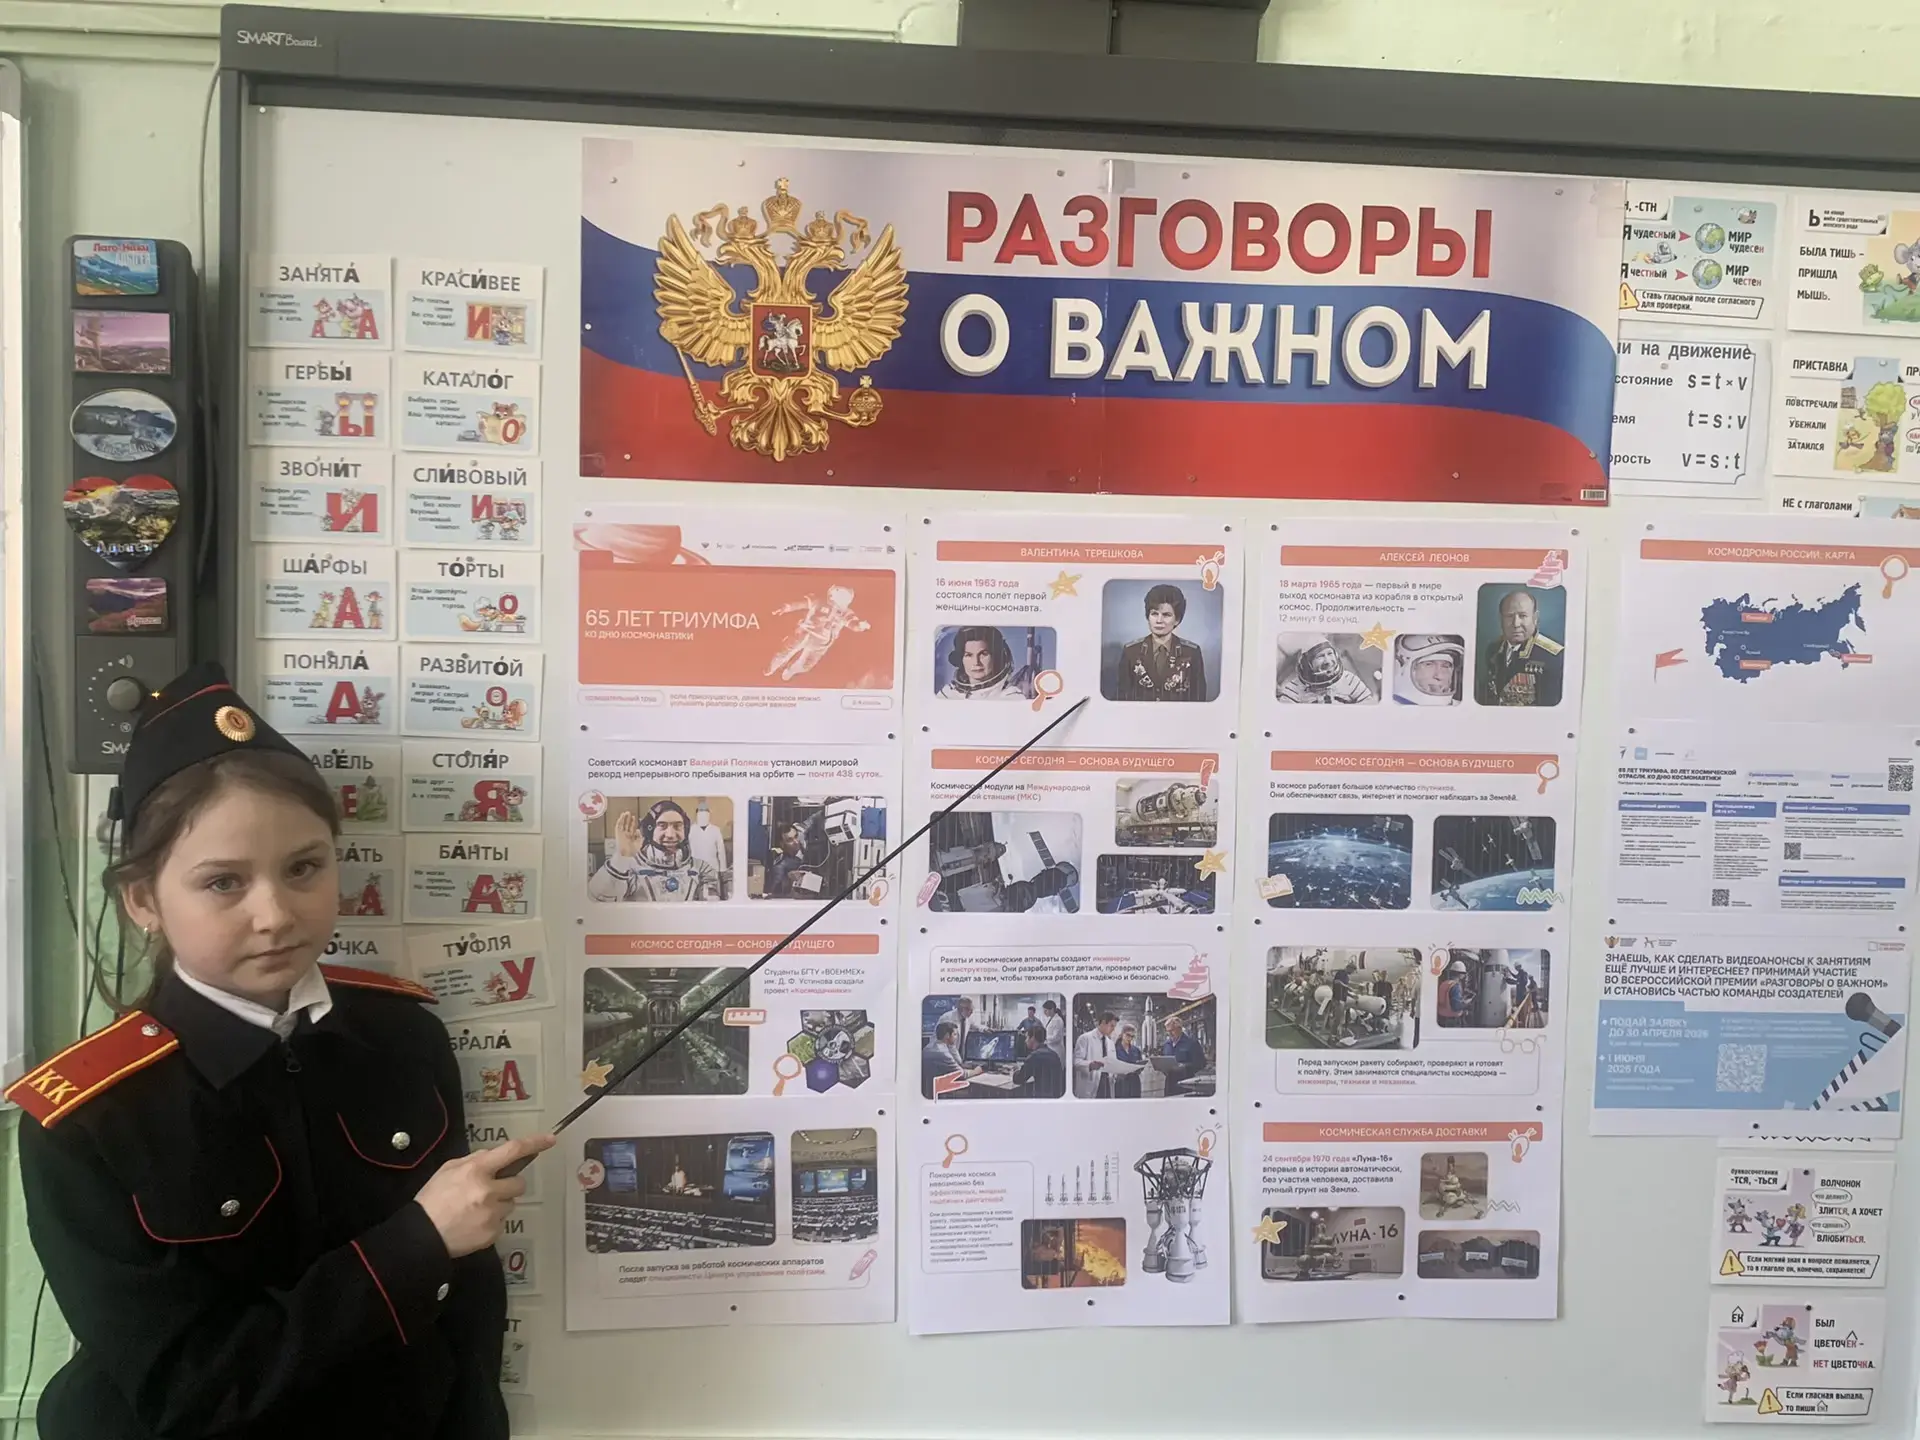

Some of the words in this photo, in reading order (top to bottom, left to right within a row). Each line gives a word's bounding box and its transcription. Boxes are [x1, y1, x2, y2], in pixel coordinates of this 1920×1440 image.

[237, 30, 286, 45] SMART
[1808, 208, 1820, 226] Ь
[946, 190, 1492, 278] РАЗГОВОРЫ
[1633, 229, 1676, 241] чудесный
[1728, 231, 1752, 242] МИР
[1729, 243, 1764, 254] чудесен
[1799, 246, 1826, 256] БЫЛА
[1829, 248, 1856, 258] ТИШЬ
[1630, 268, 1667, 278] честный
[1725, 265, 1749, 276] МИР
[1798, 268, 1837, 280] ПРИШЛА
[1732, 277, 1761, 286] честен
[1641, 290, 1661, 300] Ставь
[1664, 292, 1693, 303] гласный
[1695, 294, 1716, 303] после
[1717, 295, 1756, 306] согласного
[1797, 289, 1830, 301] МЫШЬ.
[1641, 301, 1654, 311] для
[1657, 302, 1693, 313] проверки.
[940, 293, 1010, 377] О
[1050, 297, 1491, 390] ВАЖНОМ
[1641, 343, 1660, 356] на
[1668, 345, 1751, 361] движение
[1792, 359, 1848, 373] ПРИСТАВКА
[1785, 397, 1838, 410] ПОВСТРЕЧАЛИ
[1789, 418, 1827, 431] УБЕЖАЛИ
[1787, 440, 1825, 452] ЗАТАИЛСЯ
[1782, 497, 1794, 507] НЕ
[1797, 500, 1803, 508] с
[1804, 498, 1853, 512] глаголами
[1019, 546, 1080, 557] ВАЛЕНТИНА
[1085, 548, 1144, 559] ТЕРЕШКОВА
[1379, 551, 1424, 564] АЛЕКСЕЙ
[1430, 552, 1471, 564] ЛЕОНОВ
[1707, 547, 1778, 558] КОСМОДРОМЫ
[1825, 551, 1856, 560] КАРТА
[935, 577, 945, 587] 16
[948, 580, 971, 588] июня
[974, 578, 995, 587] 1963
[998, 579, 1020, 588] года
[1279, 579, 1288, 587] 18
[1290, 581, 1317, 589] марта
[1319, 580, 1340, 588] 1965
[1375, 581, 1409, 590] первый
[1411, 581, 1416, 591] в
[1418, 583, 1442, 591] мире
[935, 591, 983, 599] состоялся
[1013, 591, 1046, 601] первой
[935, 604, 1041, 612] женщины-космонавта.
[1315, 602, 1404, 613] Продолжительность
[586, 609, 610, 626] 65
[615, 610, 655, 627] ЛЕТ
[658, 611, 760, 629] ТРИУМФА
[585, 631, 597, 639] КО
[598, 631, 620, 641] ДНЮ
[621, 631, 694, 641] КОСМОНАВТИКИ
[587, 758, 636, 766] Советский
[638, 759, 687, 767] космонавт
[689, 758, 728, 766] Валерий
[730, 758, 768, 766] Поляков
[770, 759, 817, 768] установил
[819, 758, 858, 767] мировой
[1019, 754, 1064, 766] СЕГОДНЯ
[1079, 755, 1119, 767] ОСНОВА
[1122, 755, 1176, 768] БУДУЩЕГО
[1315, 755, 1357, 768] КОСМОС
[1357, 756, 1404, 768] СЕГОДНЯ
[1418, 757, 1460, 768] ОСНОВА
[1460, 757, 1515, 768] БУДУЩЕГО
[1604, 952, 1650, 964] ЗНАЕШЬ,
[1654, 954, 1674, 965] КАК
[1677, 953, 1723, 965] СДЕЛАТЬ
[1726, 954, 1804, 966] ВИДЕОАНОНСЫ
[1807, 955, 1813, 966] К
[1816, 955, 1872, 967] ЗАНЯТИЯМ
[1630, 964, 1665, 976] ЛУЧШЕ
[1668, 964, 1675, 976] И
[1678, 964, 1749, 977] ИНТЕРЕСНЕЕ?
[1751, 965, 1809, 977] ПРИНИМАЙ
[1813, 966, 1858, 978] УЧАСТИЕ
[1603, 975, 1618, 986] ВО
[1621, 975, 1711, 987] ВСЕРОССИЙСКОЙ
[1714, 976, 1757, 988] ПРЕМИИ
[1760, 977, 1824, 989] «РАЗГОВОРЫ
[1826, 978, 1834, 989] О
[1837, 978, 1888, 990] ВАЖНОМ»
[1603, 986, 1611, 994] И
[1613, 985, 1675, 998] СТАНОВИСЬ
[1677, 986, 1720, 998] ЧАСТЬЮ
[1722, 987, 1775, 999] КОМАНДЫ
[1776, 988, 1845, 1000] СОЗДАТЕЛЕЙ
[1609, 1017, 1646, 1028] ПОДАЙ
[1649, 1017, 1688, 1028] ЗАЯВКУ
[1607, 1063, 1632, 1074] 2026
[1634, 1064, 1661, 1075] ГОДА
[1319, 1127, 1390, 1136] КОСМИЧЕСКАЯ
[1392, 1127, 1433, 1136] СЛУЖБА
[1435, 1126, 1487, 1138] ДОСТАВКИ
[1274, 1153, 1311, 1164] сентября
[1312, 1154, 1330, 1162] 1970
[1351, 1154, 1392, 1163] «Луна-16»
[1730, 1176, 1751, 1185] -ТСЯ,
[1754, 1177, 1778, 1185] -ТЬСЯ
[1820, 1178, 1862, 1188] ВОЛЧОНОК
[1262, 1185, 1293, 1194] лунный
[1293, 1185, 1317, 1194] грунт
[1330, 1185, 1359, 1193] Землю.
[1818, 1206, 1849, 1216] ЗЛИТСЯ,
[1851, 1207, 1857, 1215] А
[1859, 1208, 1883, 1216] ХОЧЕТ
[1379, 1223, 1399, 1239] 16
[1816, 1234, 1866, 1244] ВЛЮБИТЬСЯ.
[1815, 1319, 1835, 1328] БЫЛ
[1814, 1339, 1857, 1349] ЦВЕТОЧЕК
[1813, 1360, 1829, 1369] НЕТ
[1831, 1361, 1876, 1370] ЦВЕТОЧКА.
